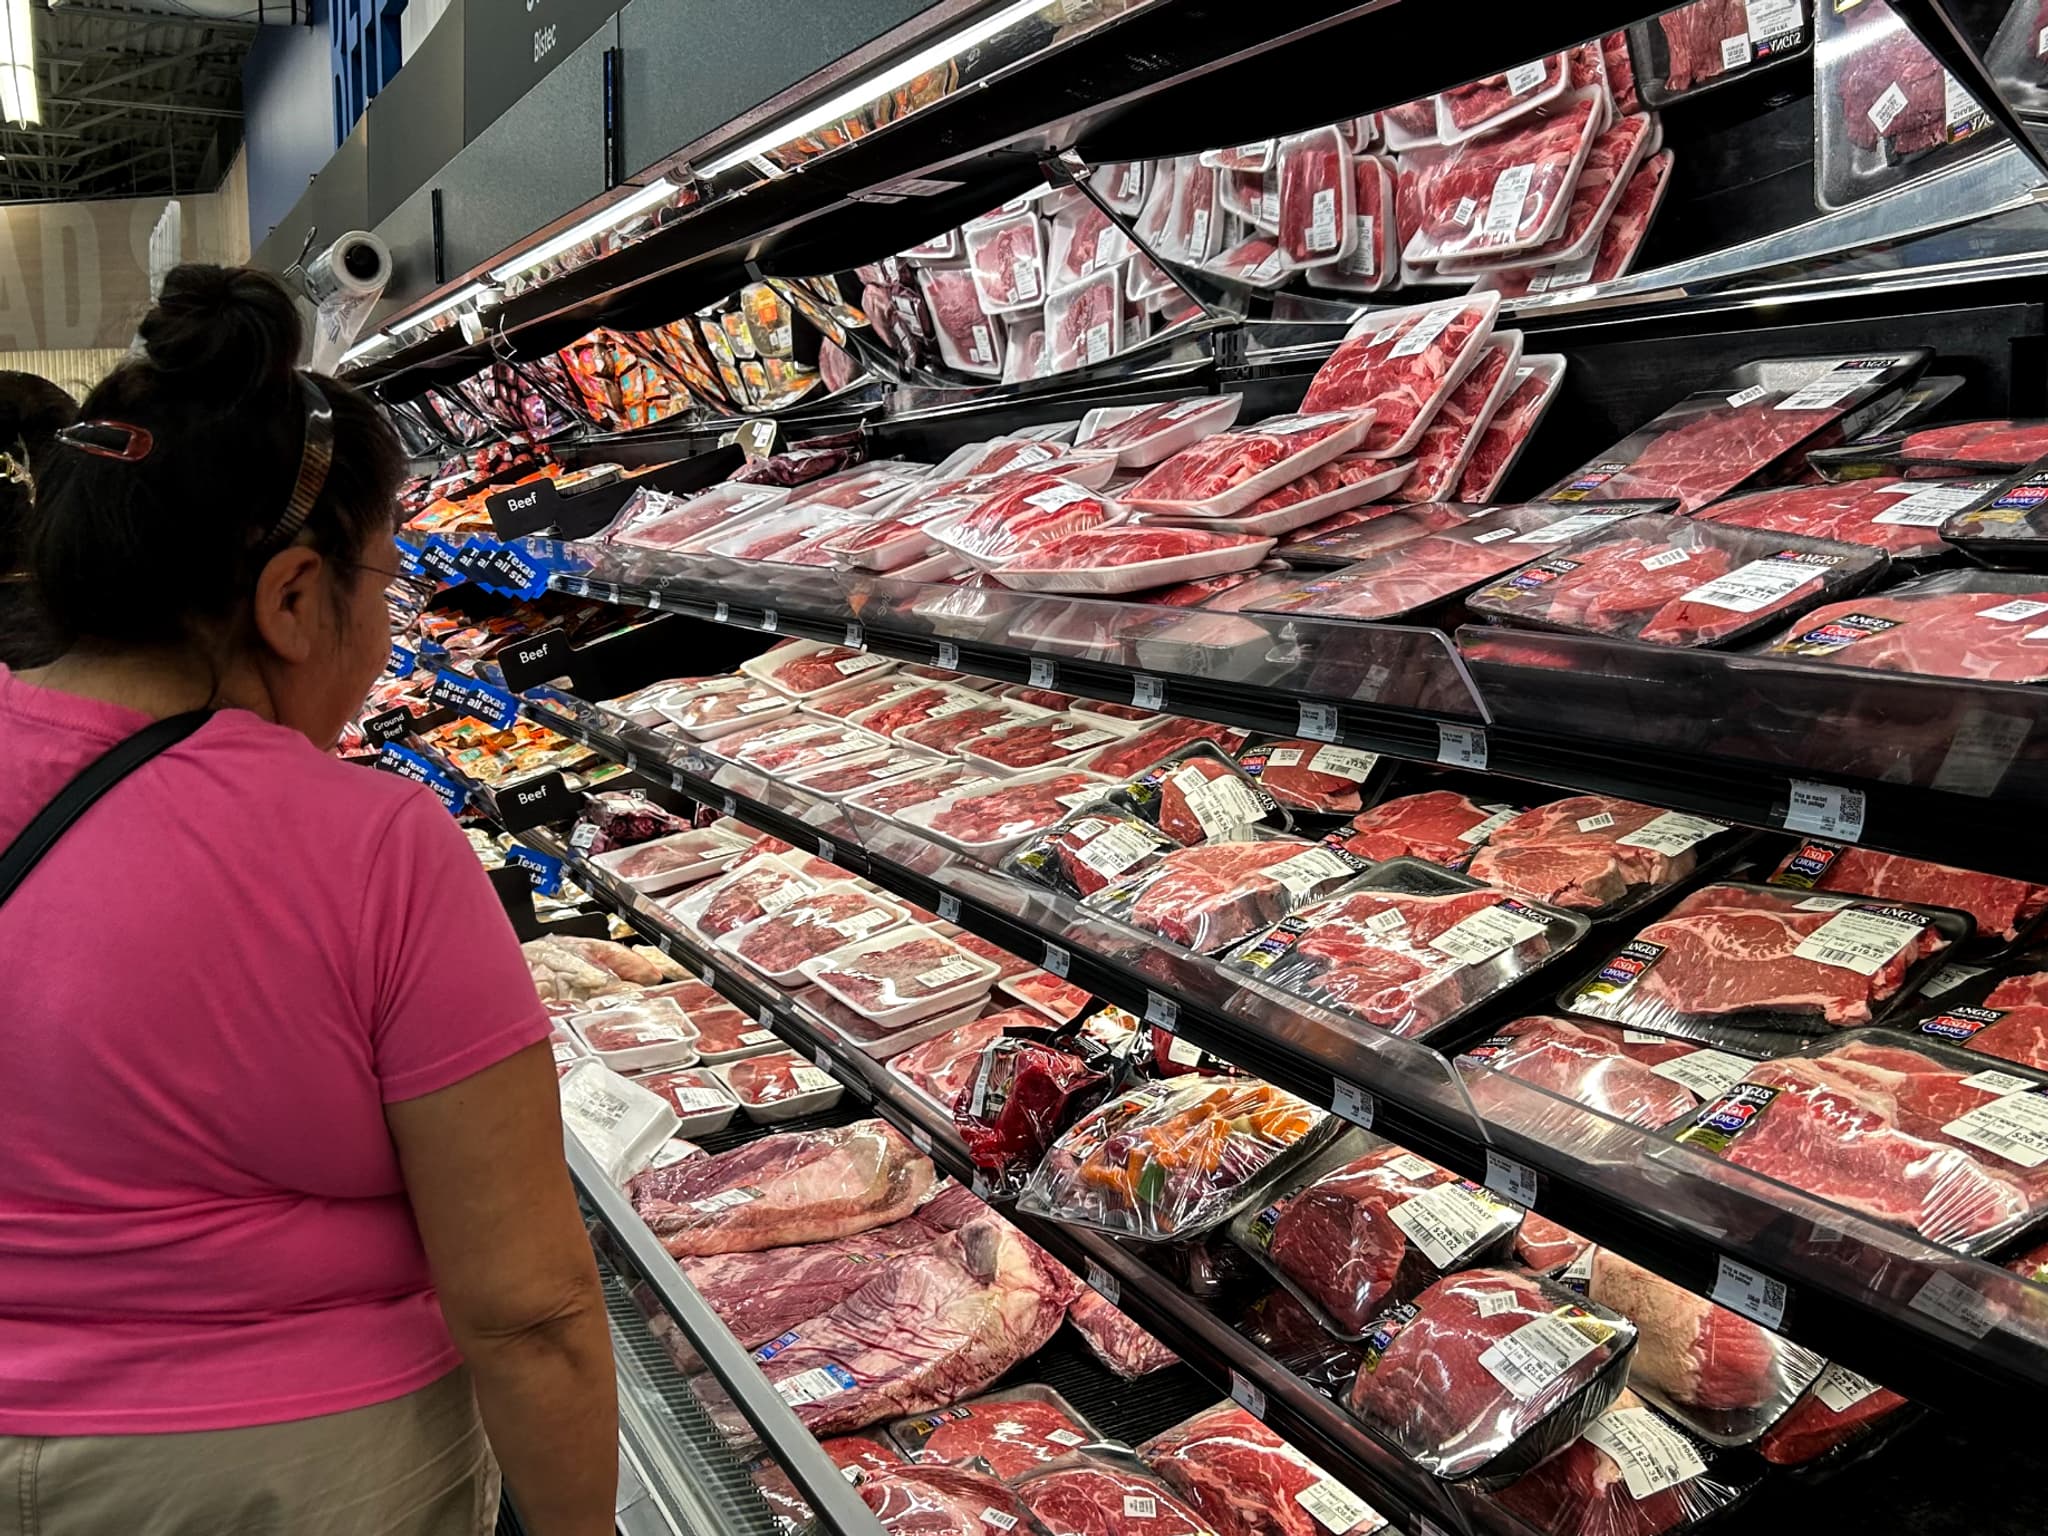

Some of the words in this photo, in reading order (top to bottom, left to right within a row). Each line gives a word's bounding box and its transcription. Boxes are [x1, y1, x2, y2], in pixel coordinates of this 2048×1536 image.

[533, 23, 557, 63] Bistec
[507, 491, 537, 512] Beef
[424, 552, 437, 565] all
[436, 560, 459, 577] star
[459, 555, 474, 567] al
[477, 557, 490, 569] al
[506, 551, 537, 579] Texas
[494, 558, 509, 573] all
[509, 570, 532, 589] star
[519, 643, 549, 664] Beef
[435, 689, 448, 699] all
[476, 689, 507, 710] Texas
[467, 698, 482, 711] all
[482, 704, 505, 721] star
[372, 713, 405, 732] Ground
[383, 725, 404, 740] Beef
[381, 756, 393, 766] all
[388, 749, 403, 760] Tex
[398, 766, 411, 777] all
[429, 779, 456, 798] Texas
[518, 785, 548, 806] Beef
[1257, 792, 1278, 811] GUS
[517, 855, 548, 874] Texas
[529, 872, 548, 886] tar
[1877, 906, 1931, 925] ANGUS
[1627, 942, 1660, 957] ANGUS
[1603, 968, 1634, 979] CHOICE
[1613, 960, 1637, 971] USDA
[1952, 1006, 2002, 1019] ANGUS
[1928, 1022, 1969, 1036] CHOICE
[1470, 1200, 1493, 1221] ROAST
[1681, 1440, 1699, 1465] ROAST
